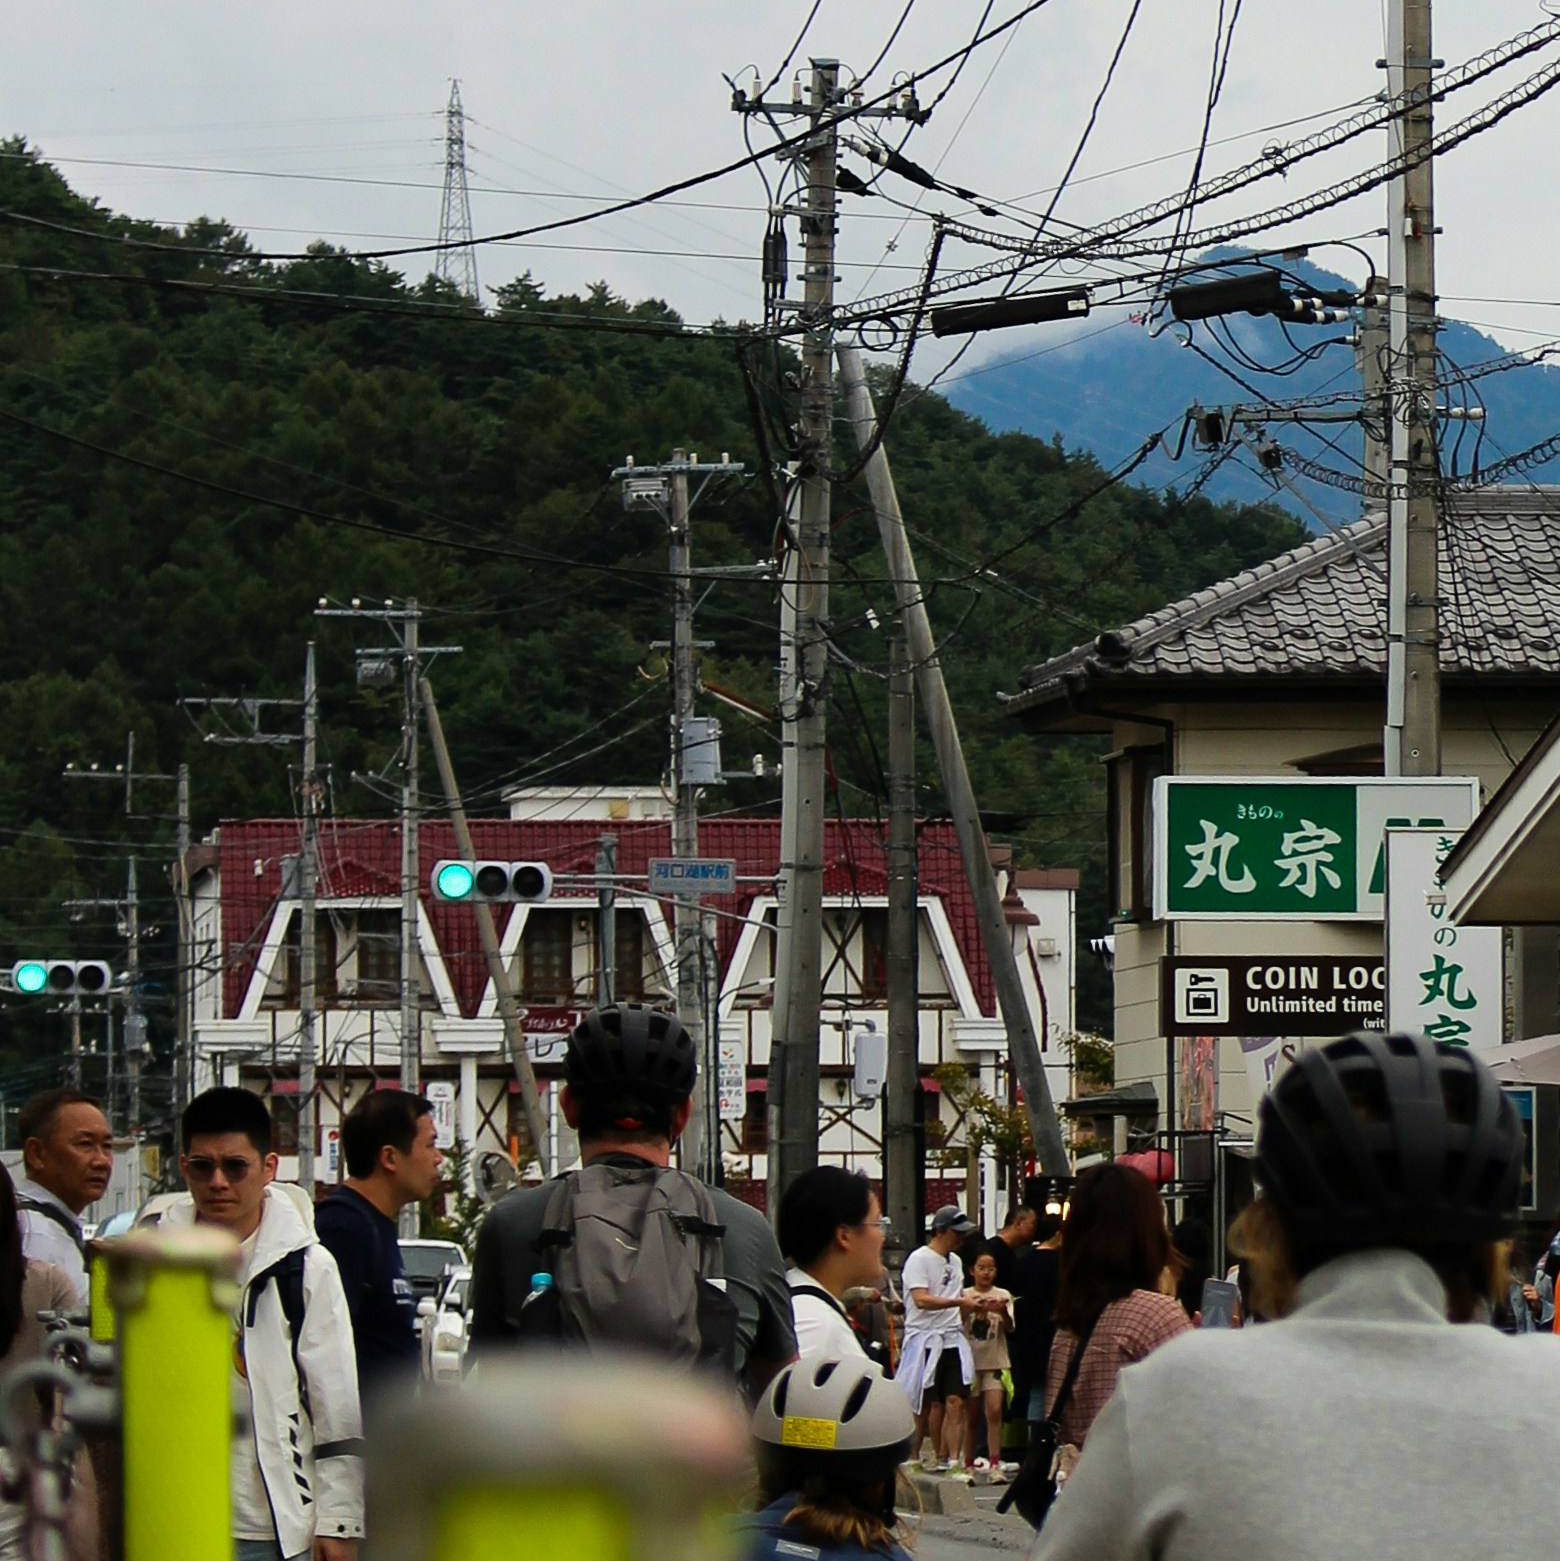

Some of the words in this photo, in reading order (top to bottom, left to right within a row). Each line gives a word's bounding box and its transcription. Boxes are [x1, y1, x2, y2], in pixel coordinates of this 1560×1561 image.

[1236, 803, 1284, 820] きものの
[1182, 819, 1342, 898] 丸宗
[1246, 966, 1319, 990] COIN
[1246, 996, 1337, 1013] Unlimited
[1343, 996, 1384, 1013] time
